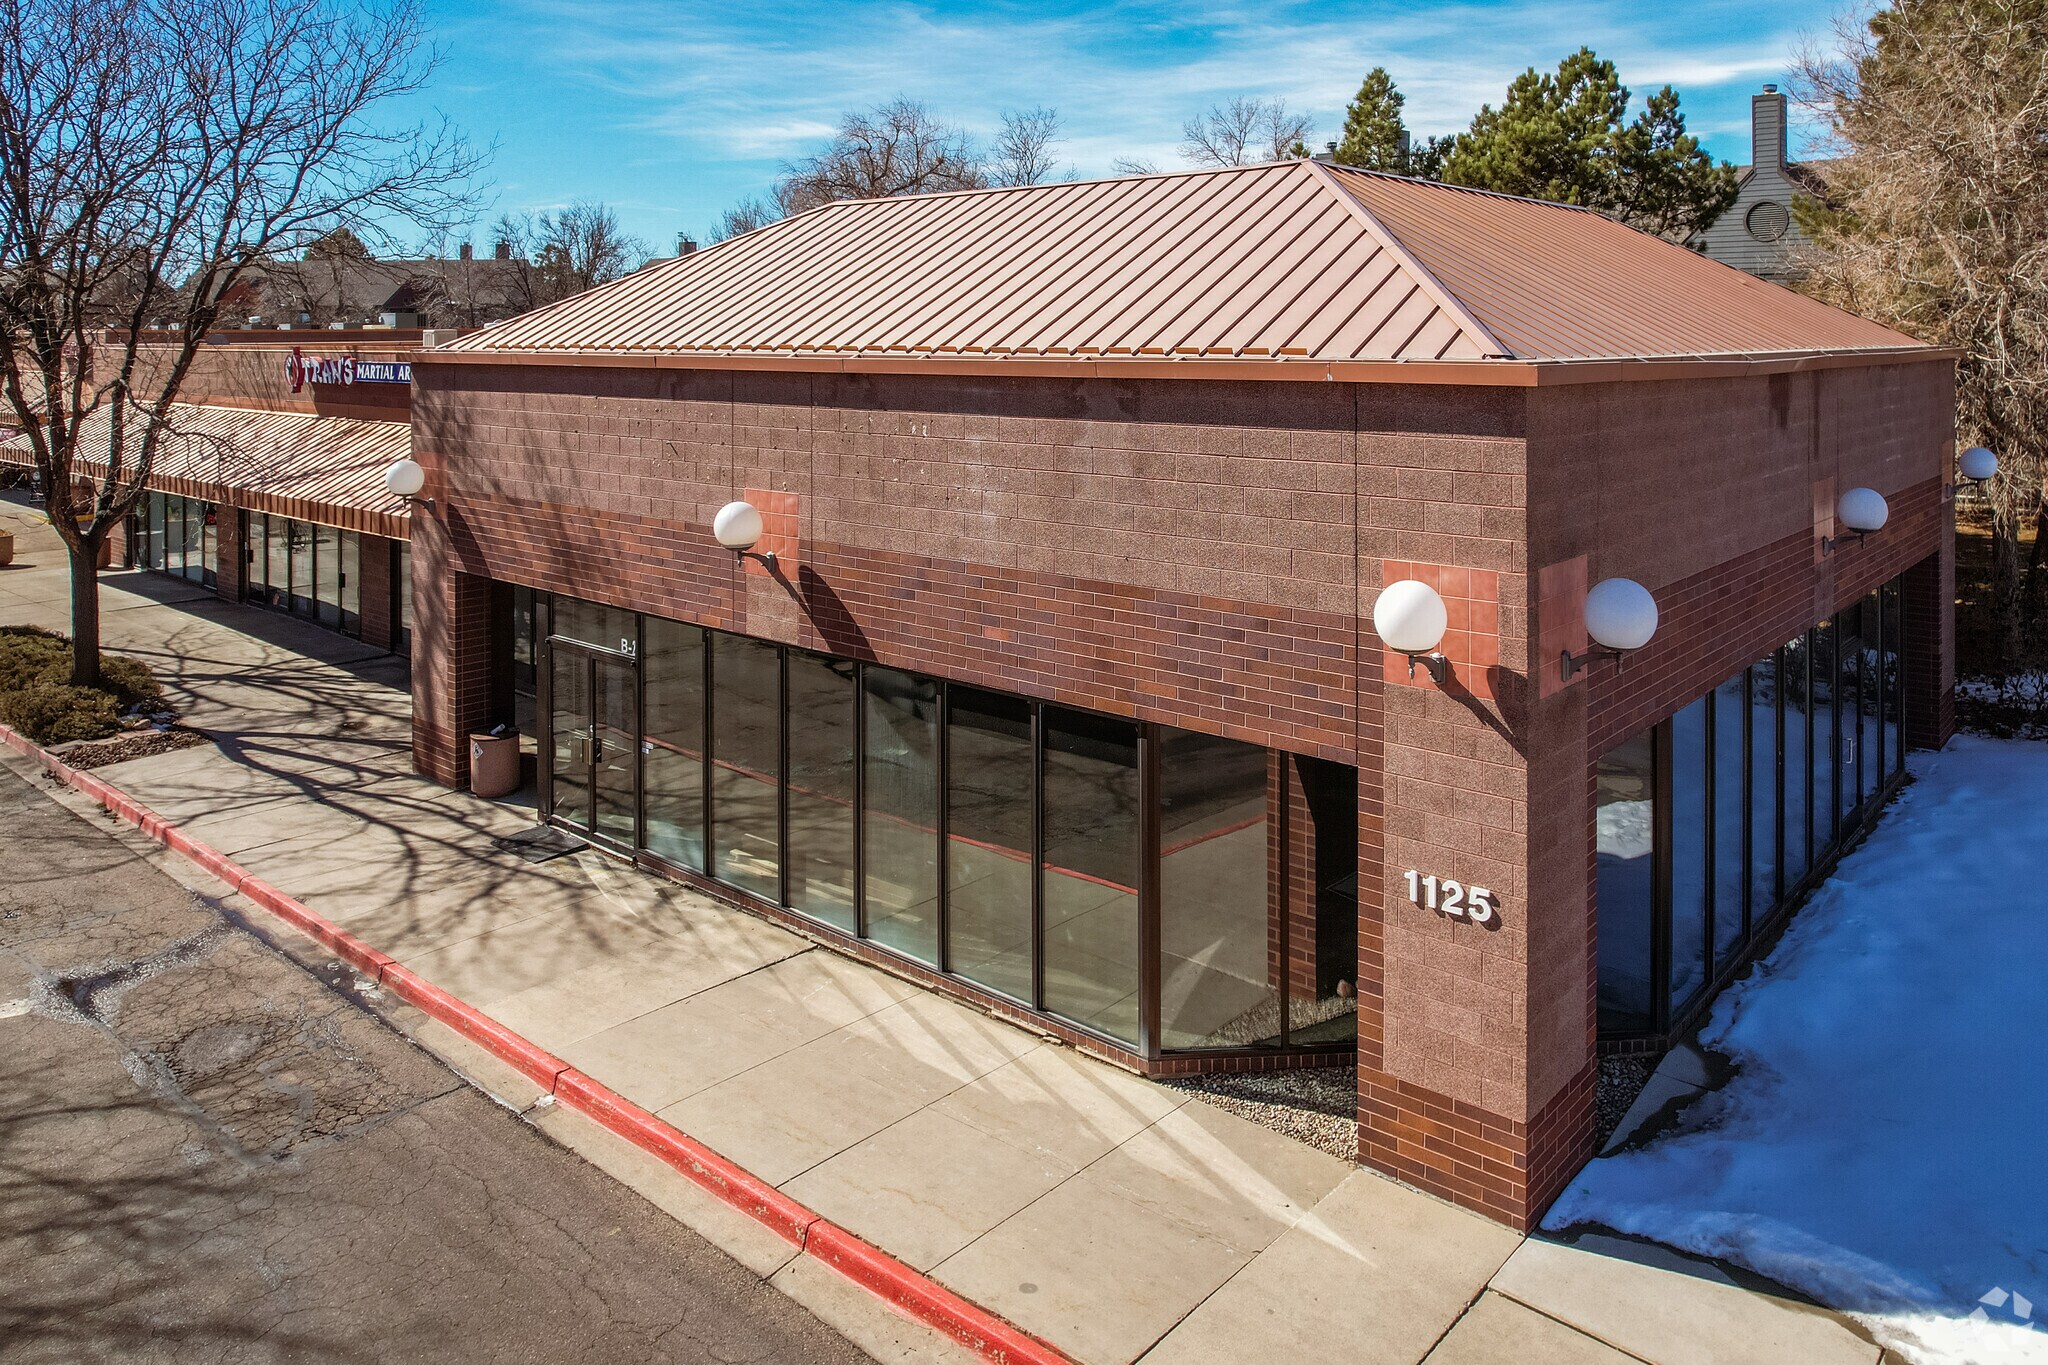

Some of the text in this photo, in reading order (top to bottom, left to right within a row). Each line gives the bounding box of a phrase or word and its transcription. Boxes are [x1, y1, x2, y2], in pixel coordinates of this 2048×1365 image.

[301, 356, 411, 385] TRAN'S MARTIAL AR
[1404, 869, 1493, 922] 1125
